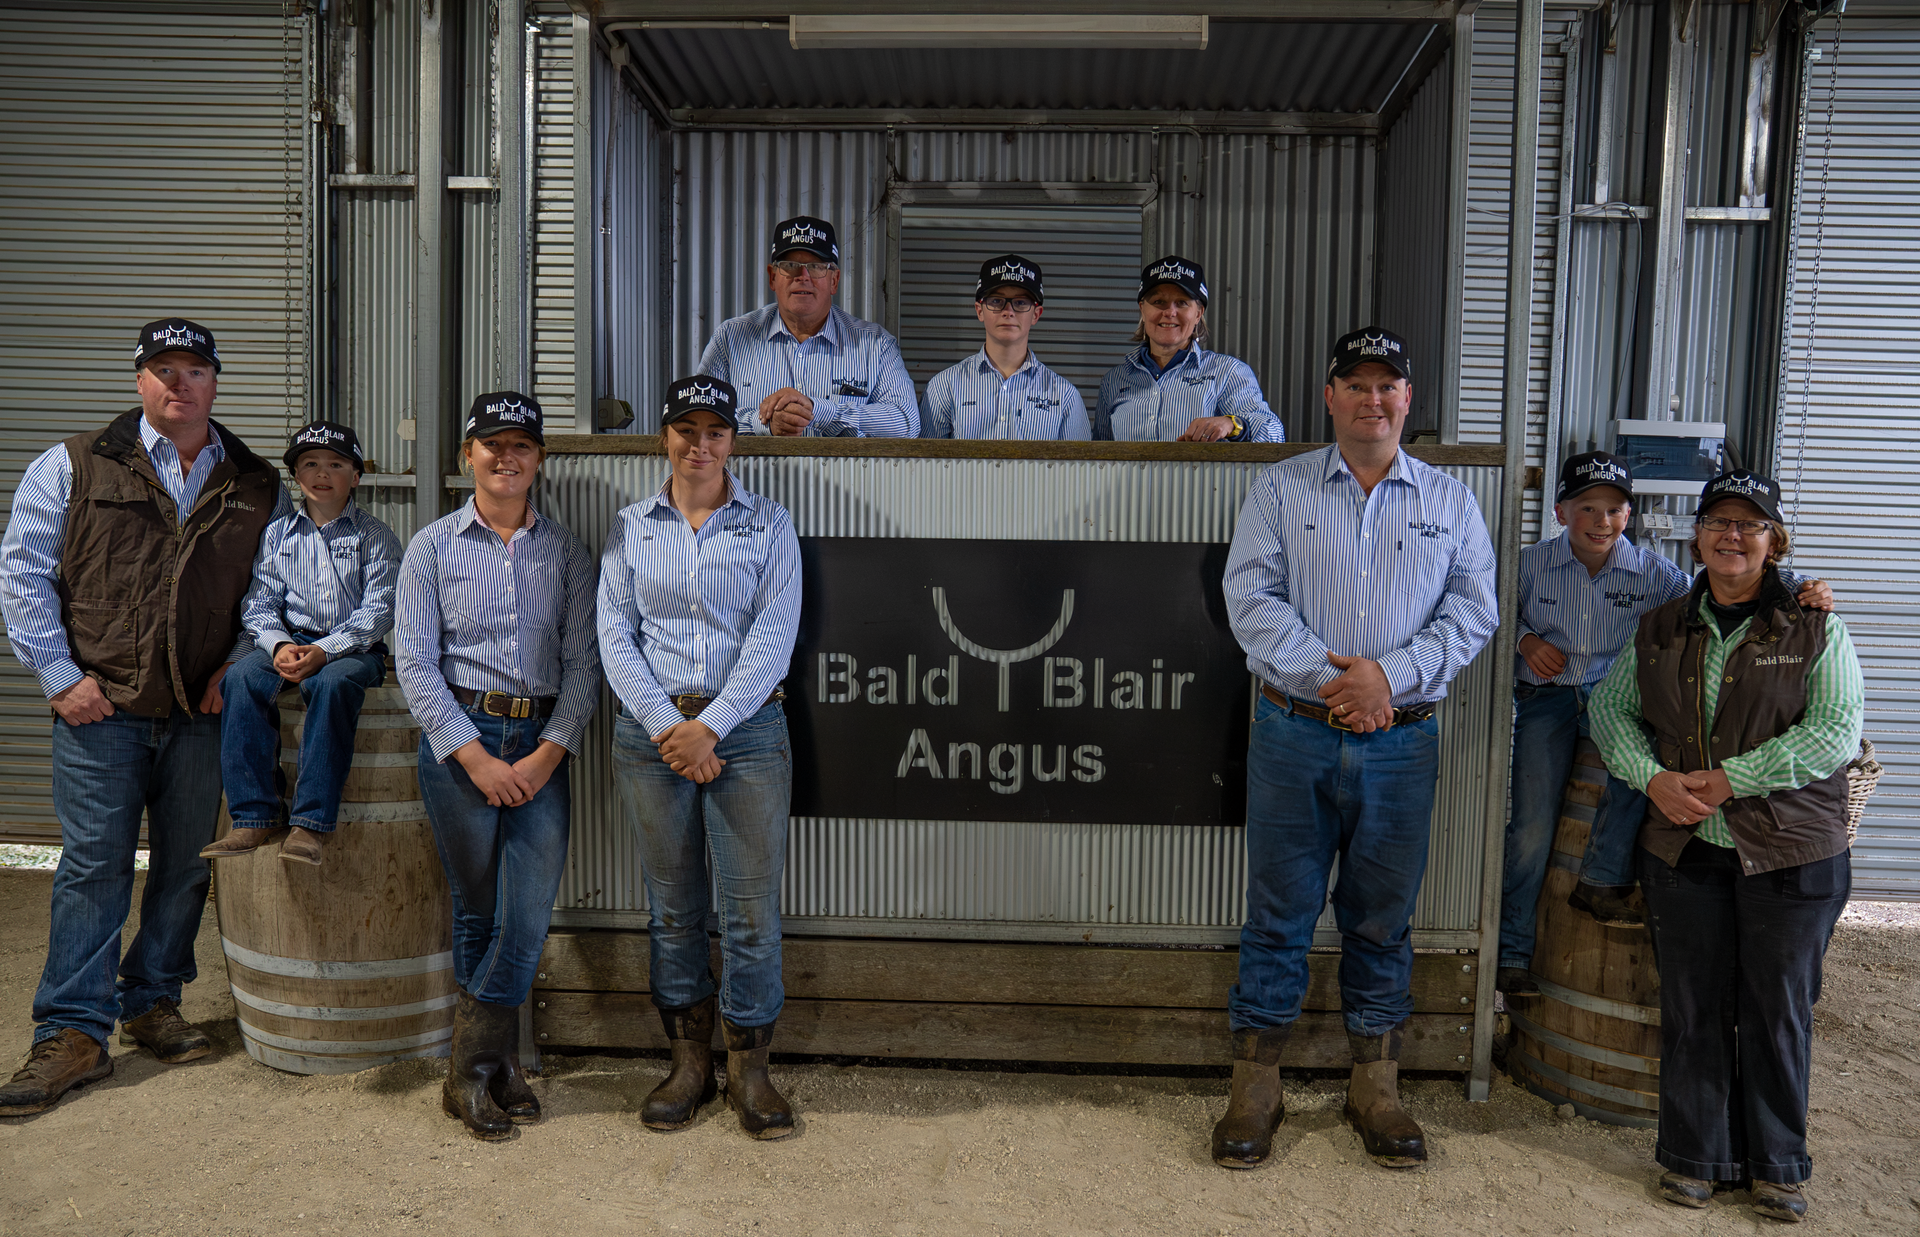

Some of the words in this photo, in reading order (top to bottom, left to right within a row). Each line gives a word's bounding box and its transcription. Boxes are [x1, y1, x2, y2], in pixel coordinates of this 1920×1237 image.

[782, 227, 797, 240] BALD
[809, 228, 827, 242] BLAIR
[790, 235, 814, 244] ANGUS
[990, 265, 1006, 276] BALD
[1019, 266, 1036, 281] BLAIR
[1001, 272, 1024, 282] ANGUS
[1150, 265, 1165, 277] BALD
[1177, 266, 1195, 279] BLAIR
[1158, 272, 1181, 280] ANGUS
[152, 329, 171, 341] BALD
[186, 329, 206, 345] BLAIR
[165, 337, 193, 347] ANGUS
[1347, 338, 1367, 351] BALD
[1382, 338, 1401, 353] BLAIR
[1360, 345, 1388, 356] ANGUS
[678, 387, 695, 400] BALD
[711, 388, 729, 404] BLAIR
[689, 395, 716, 405] ANGUS
[486, 403, 505, 414] BALD
[520, 405, 537, 421] BLAIR
[499, 412, 526, 424] ANGUS
[297, 431, 311, 444] BALD
[324, 429, 345, 442] BLAIR
[1575, 463, 1595, 476] BALD
[1609, 464, 1627, 479] BLAIR
[1589, 470, 1616, 481] ANGUS
[1712, 479, 1732, 492] BALD
[1747, 479, 1770, 496] BLAIR
[1724, 485, 1753, 495] ANGUS
[224, 500, 236, 508] ald
[237, 501, 256, 512] Blair
[1755, 656, 1777, 666] Bald
[1778, 654, 1804, 664] Blair
[818, 652, 959, 706] Bald
[1043, 656, 1195, 710] Blair
[896, 728, 1106, 795] Angus
